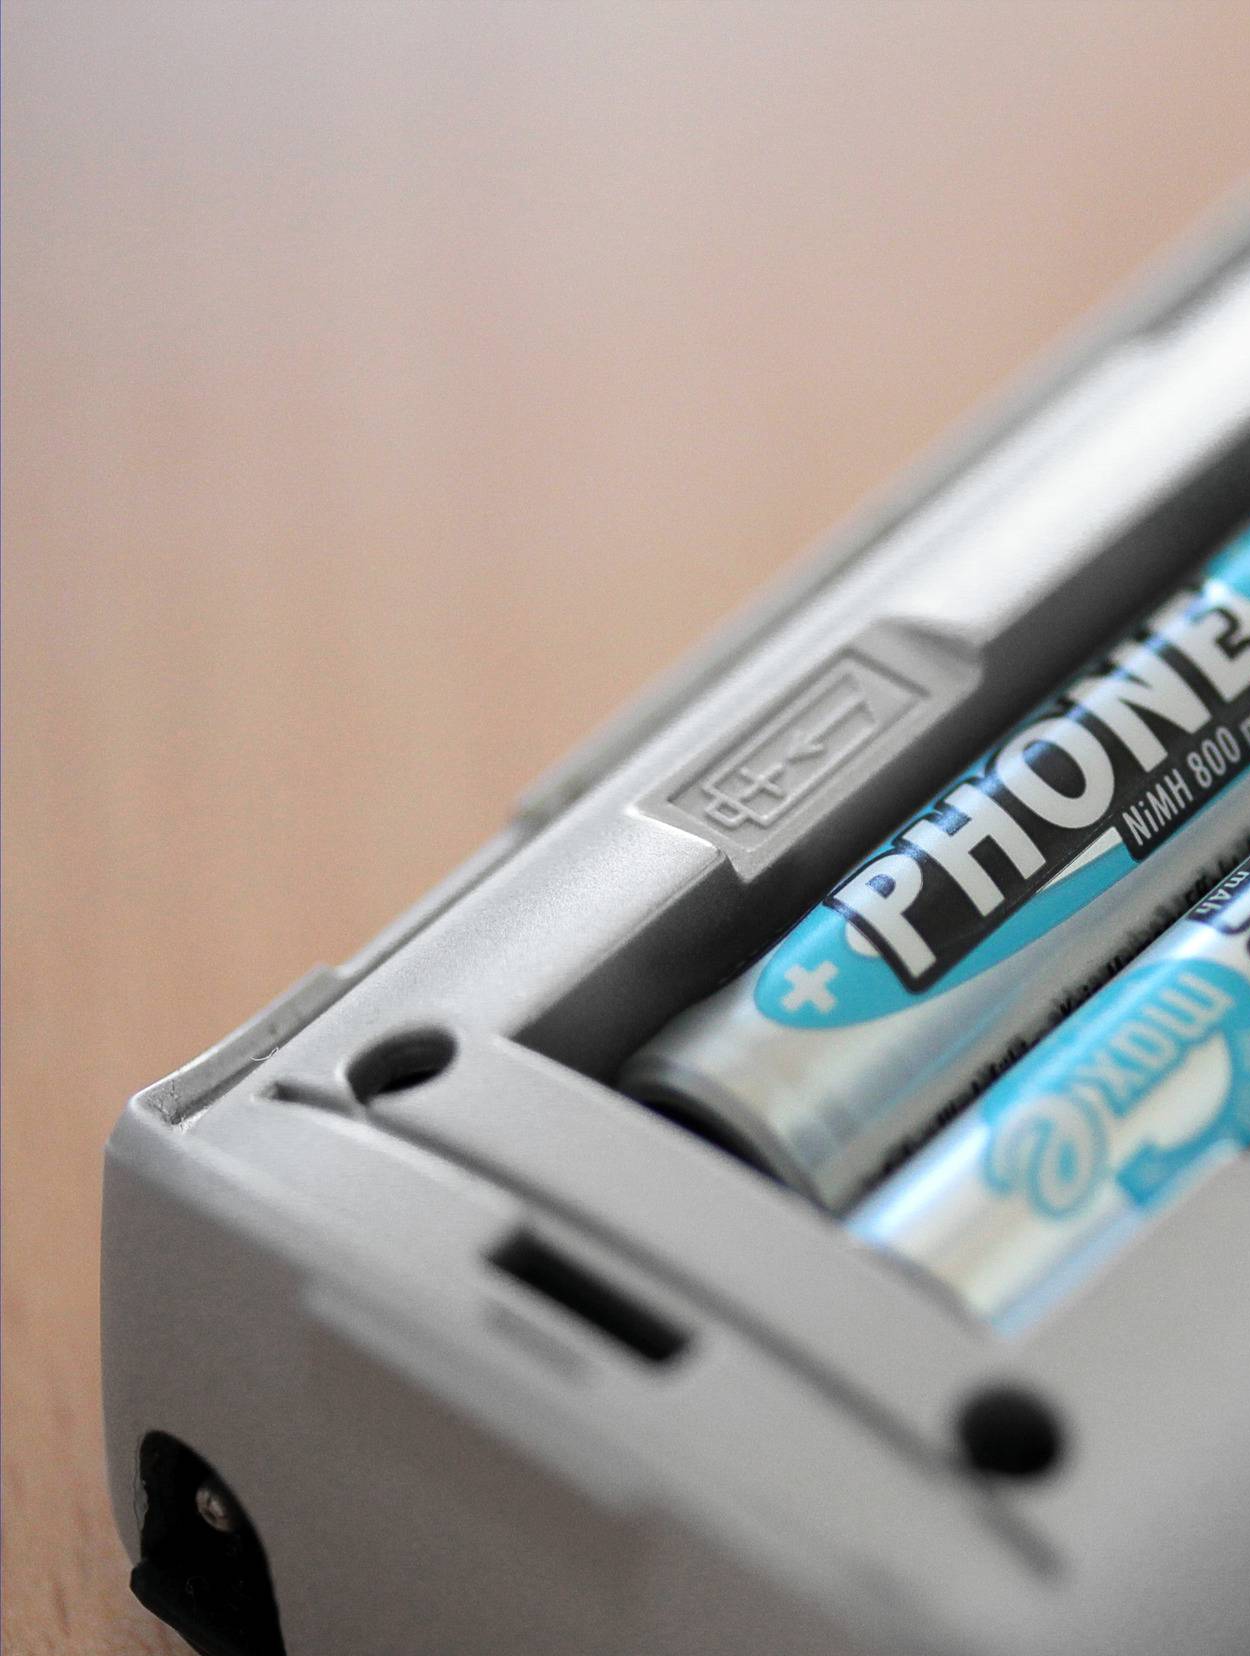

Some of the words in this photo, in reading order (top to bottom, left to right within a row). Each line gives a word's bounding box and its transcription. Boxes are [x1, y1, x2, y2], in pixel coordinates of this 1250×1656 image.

[1122, 768, 1194, 846] NiMH
[1187, 726, 1241, 788] 800
[1196, 871, 1250, 914] mAh
